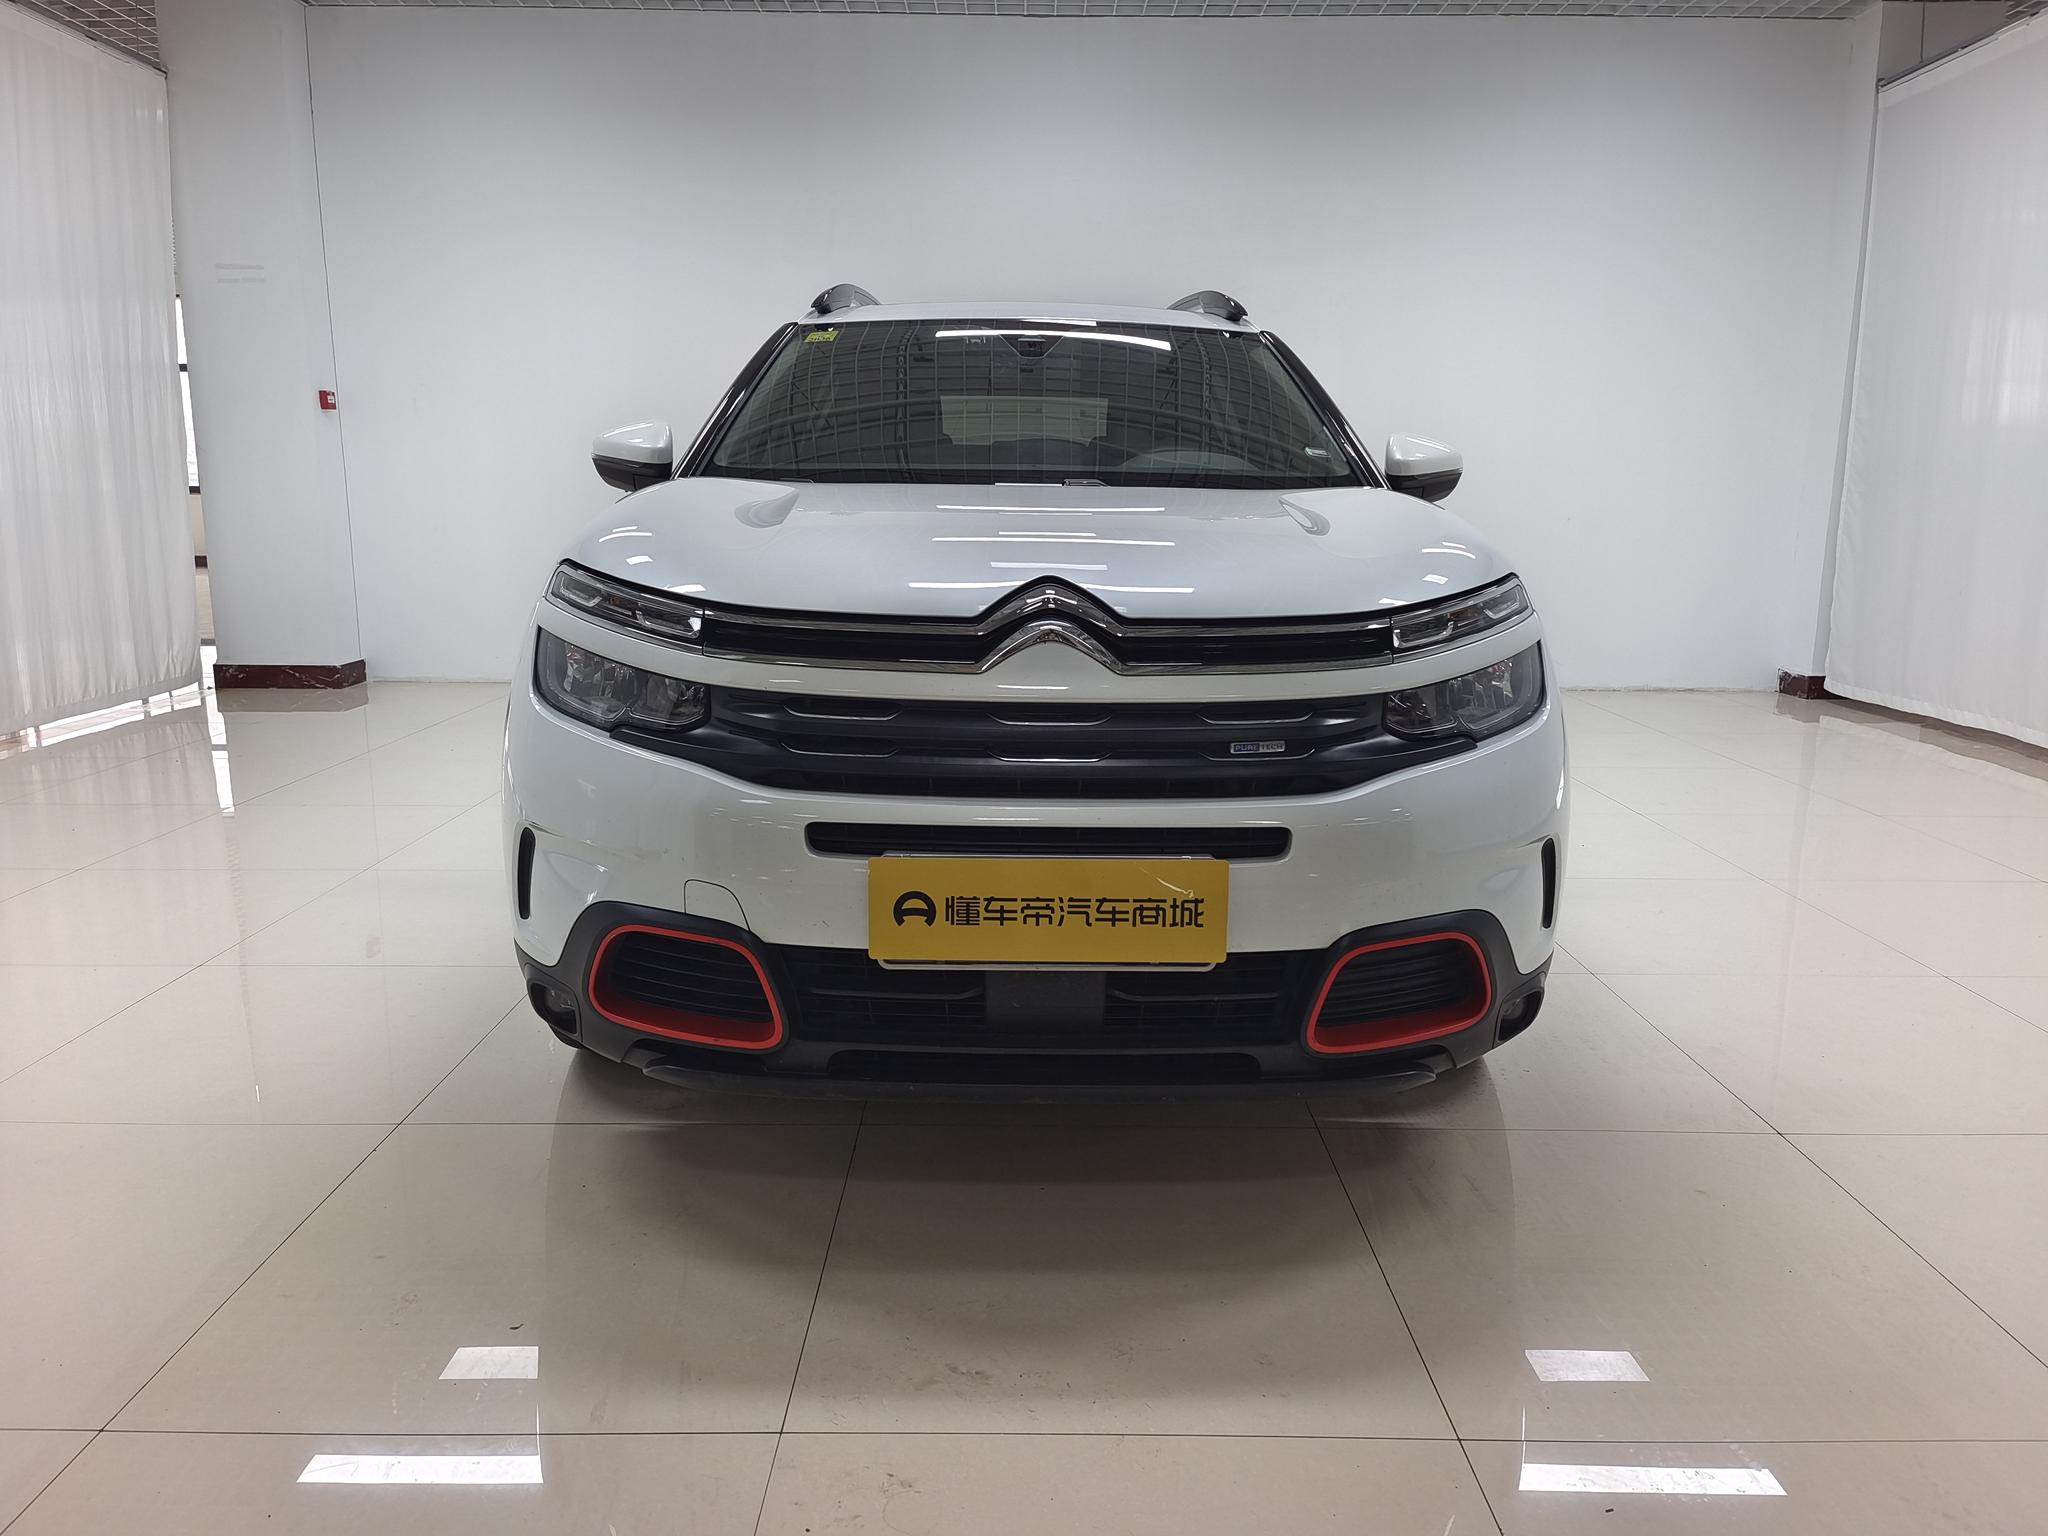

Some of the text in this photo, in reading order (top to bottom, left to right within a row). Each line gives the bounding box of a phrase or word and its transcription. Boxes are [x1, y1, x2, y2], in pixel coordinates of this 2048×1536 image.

[945, 896, 1204, 928] 懂车帝汽车商城
